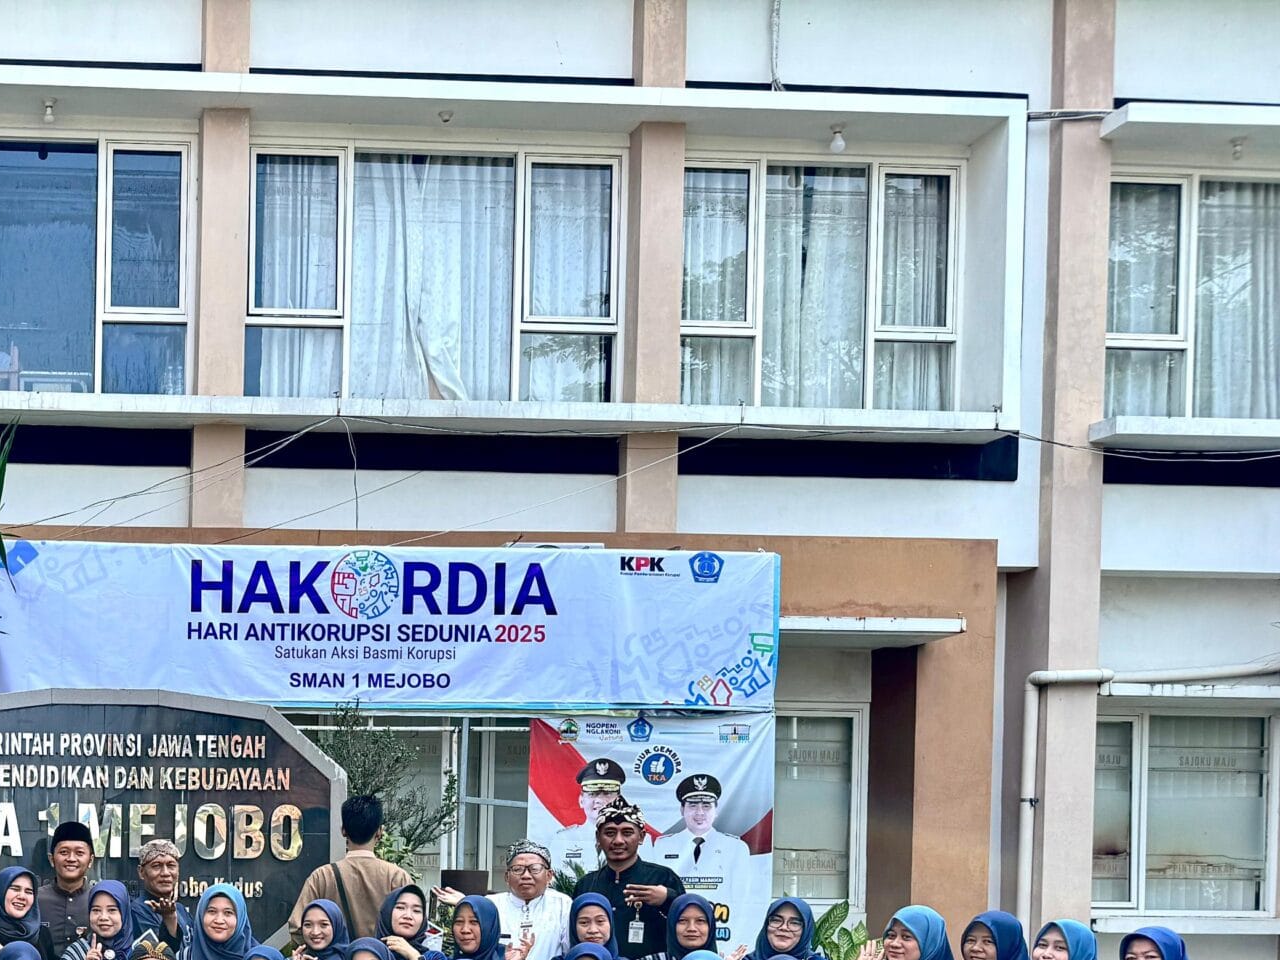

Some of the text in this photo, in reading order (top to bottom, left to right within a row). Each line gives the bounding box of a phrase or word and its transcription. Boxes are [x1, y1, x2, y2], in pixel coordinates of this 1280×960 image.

[620, 556, 665, 572] KPK
[187, 622, 546, 642] HARI ANTIKORUPSI SEDUNIA 2025
[275, 645, 456, 663] Satukan Aksi Basmi Korupsi
[289, 672, 450, 689] SMAN 1 MEJOBO
[60, 732, 142, 757] PROVINSI
[147, 733, 193, 758] JAWA
[195, 734, 266, 759] TENGAH
[634, 745, 682, 774] JUJUR GEMBIRA
[114, 765, 154, 790] DAN
[159, 766, 291, 791] KEBUDAYAAN
[647, 774, 667, 782] TKA
